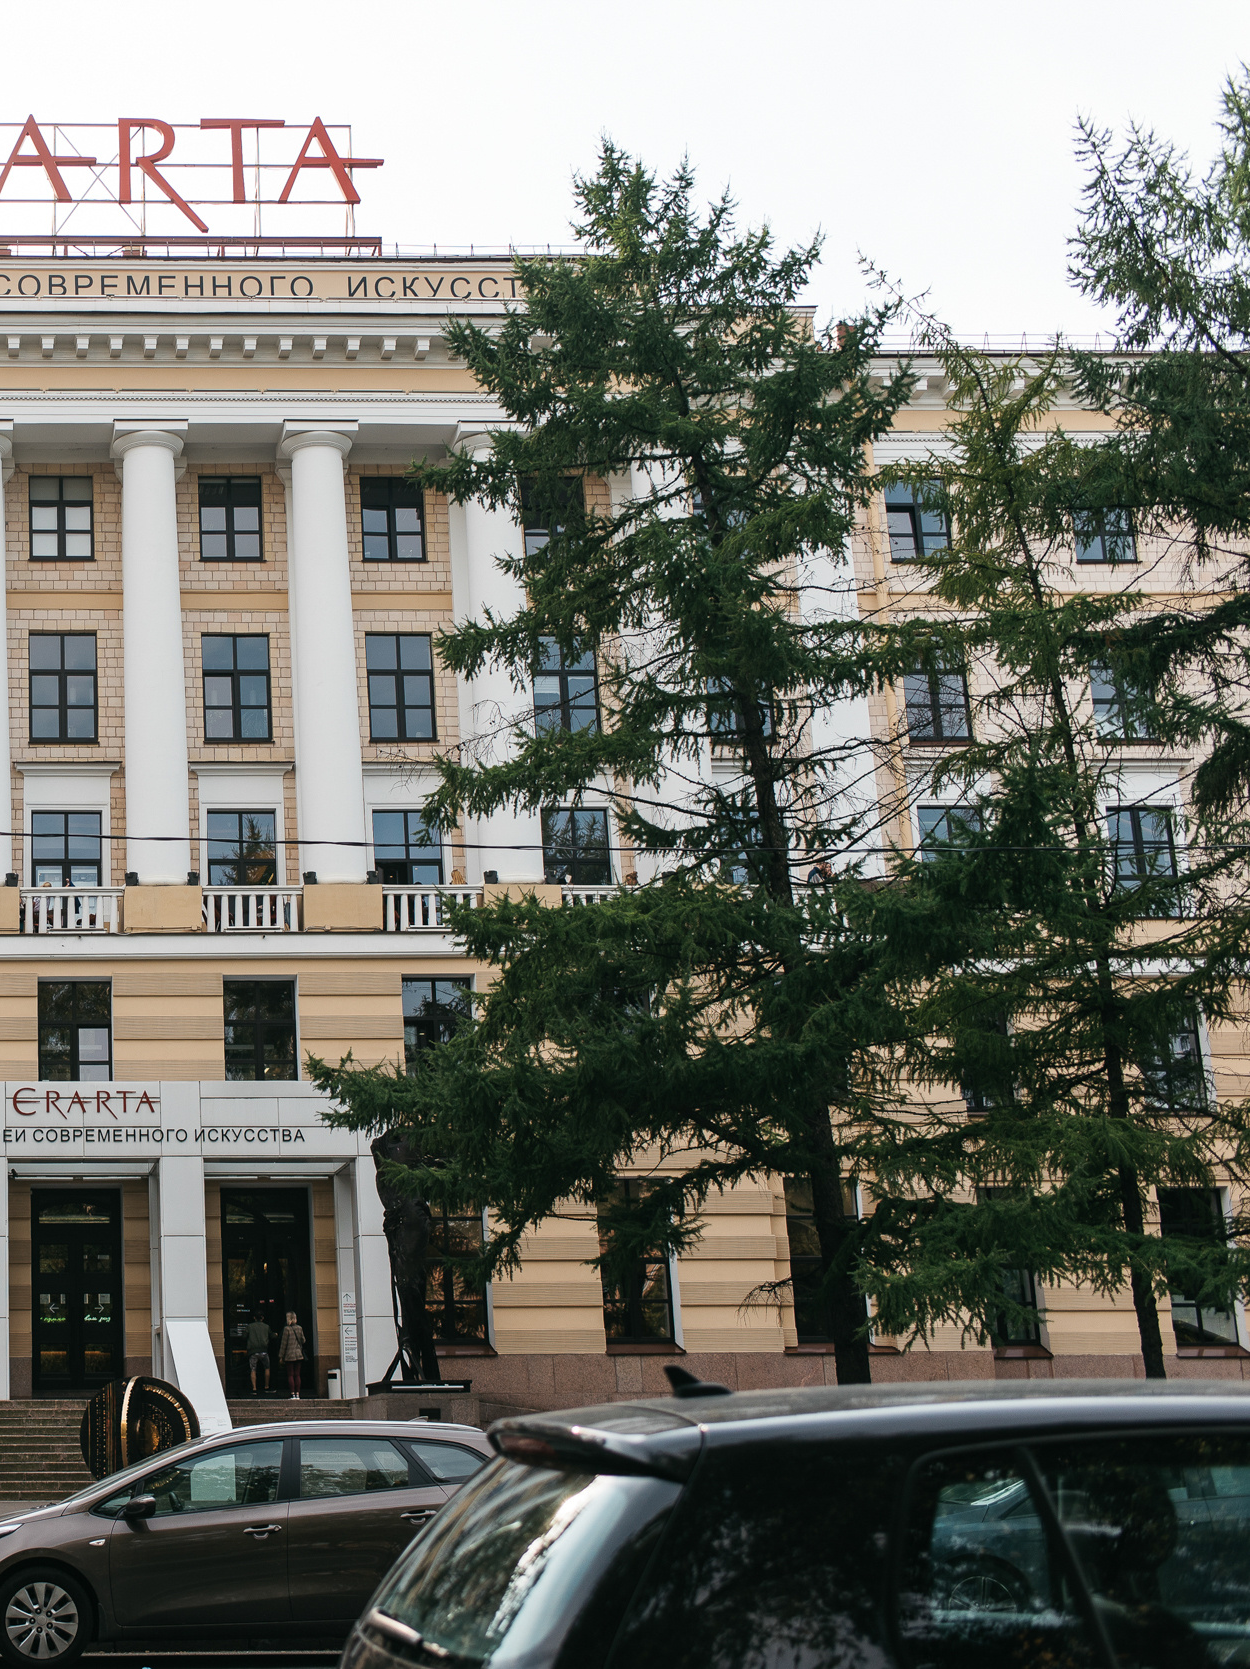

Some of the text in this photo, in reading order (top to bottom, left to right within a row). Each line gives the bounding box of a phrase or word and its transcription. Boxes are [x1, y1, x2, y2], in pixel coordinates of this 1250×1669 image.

[347, 276, 524, 299] ИСКУССТ
[12, 1087, 160, 1120] ERARTA
[32, 1128, 188, 1143] СОВРЕМЕННОГО
[194, 1128, 306, 1143] ИСКУССТВА
